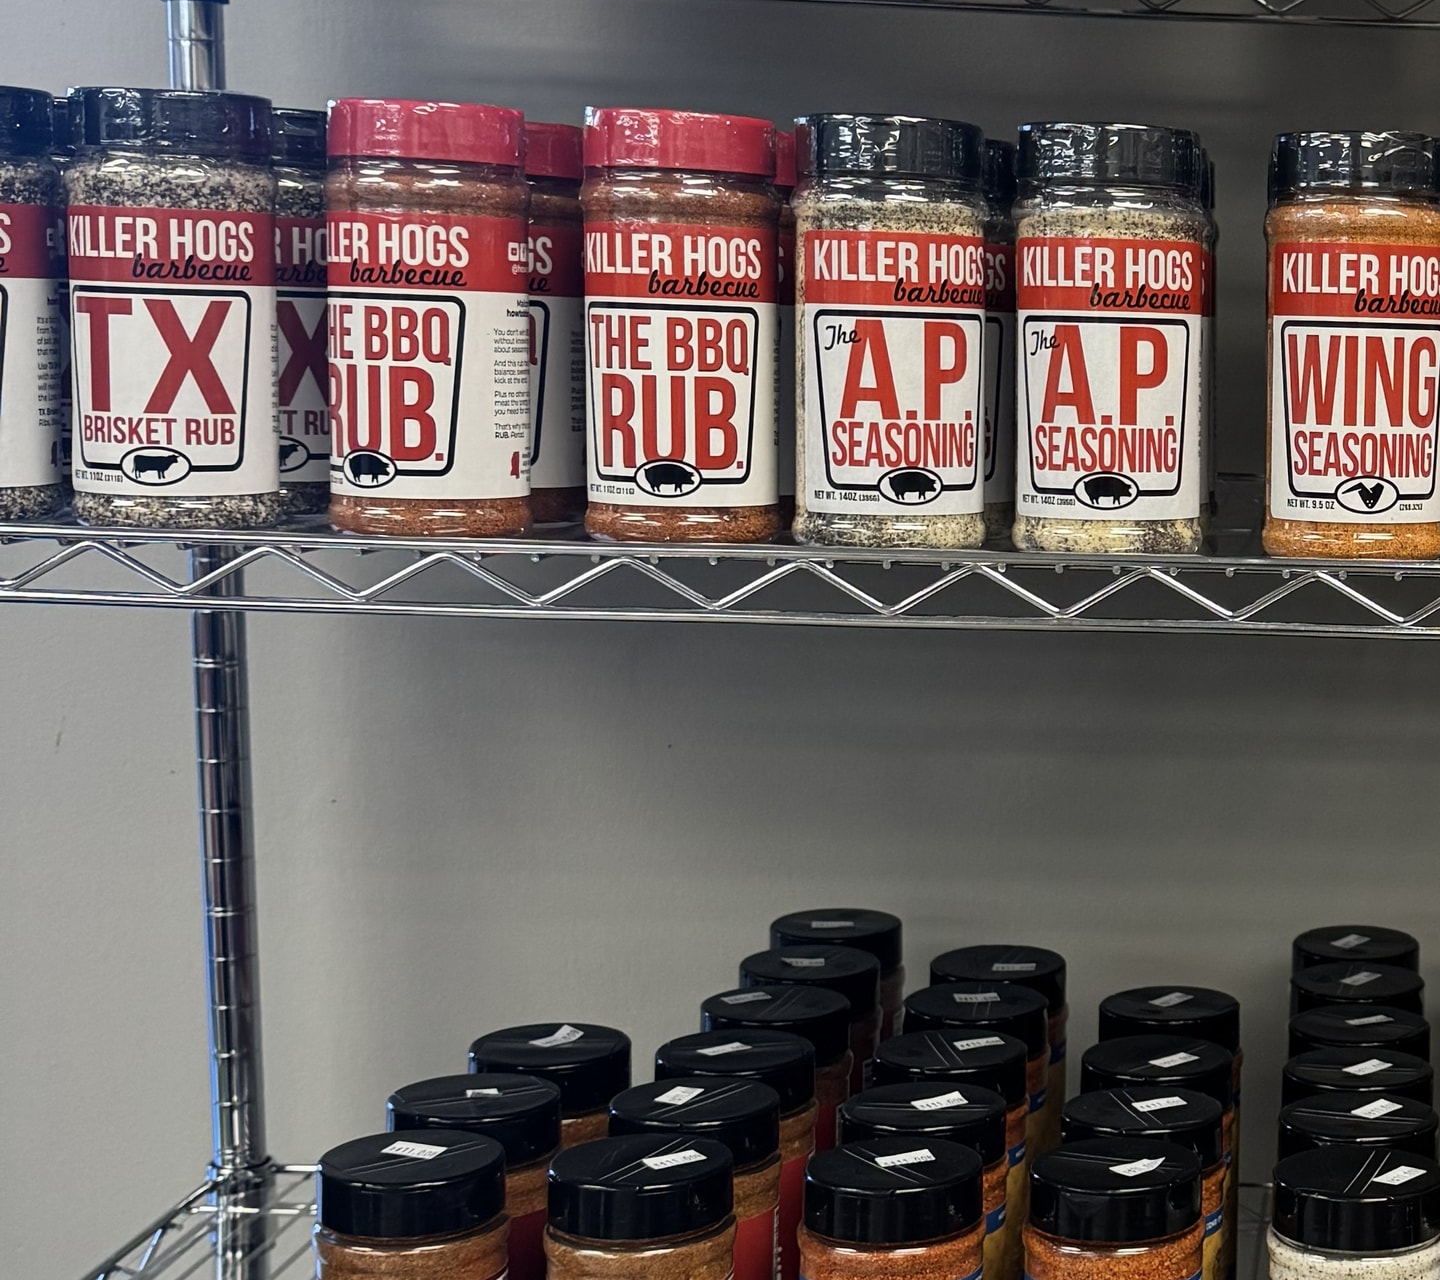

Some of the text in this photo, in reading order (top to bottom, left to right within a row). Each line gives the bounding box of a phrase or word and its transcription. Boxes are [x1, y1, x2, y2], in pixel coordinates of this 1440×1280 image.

[69, 215, 255, 263] KILLER HOGS
[813, 239, 985, 286] KILLER HOGS
[132, 253, 253, 281] barbecue
[1281, 251, 1380, 296] KILLER
[76, 295, 238, 415] TX
[591, 314, 749, 376] THE BBQ
[824, 325, 863, 351] The
[839, 319, 973, 421] A.P.
[1041, 325, 1175, 426] A.P.
[1287, 332, 1437, 429] WING
[84, 415, 236, 445] BRISKET RUB
[602, 373, 745, 470] RUB.
[831, 420, 975, 468] SEASONING
[1293, 430, 1433, 479] SEASONING
